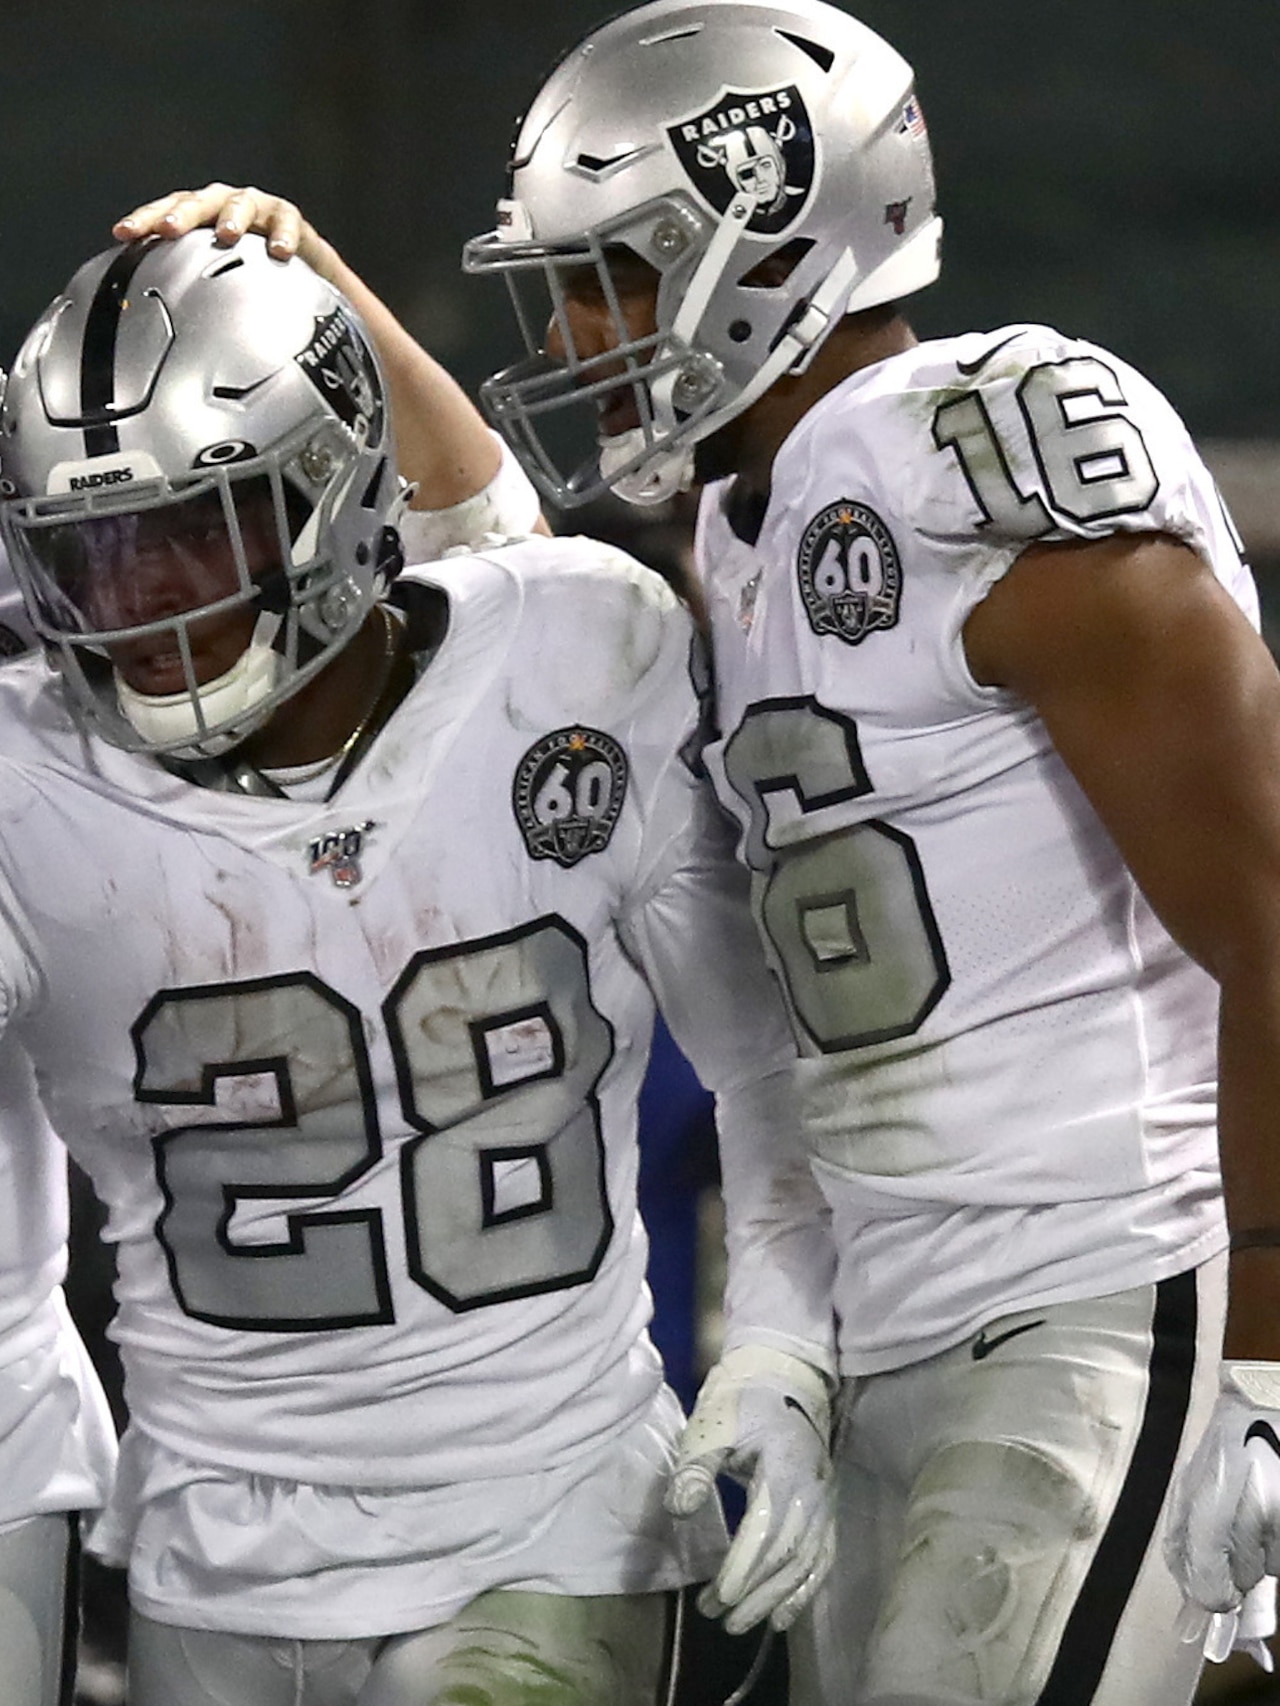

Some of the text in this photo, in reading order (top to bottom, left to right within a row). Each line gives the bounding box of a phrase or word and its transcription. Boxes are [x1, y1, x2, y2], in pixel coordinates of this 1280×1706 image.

[680, 91, 792, 143] RAIDERS
[303, 311, 347, 368] RAIDE
[69, 467, 134, 492] RAIDERS
[931, 355, 1160, 542] 16
[813, 535, 884, 600] 60
[532, 760, 614, 827] 60
[130, 912, 615, 1333] 28
